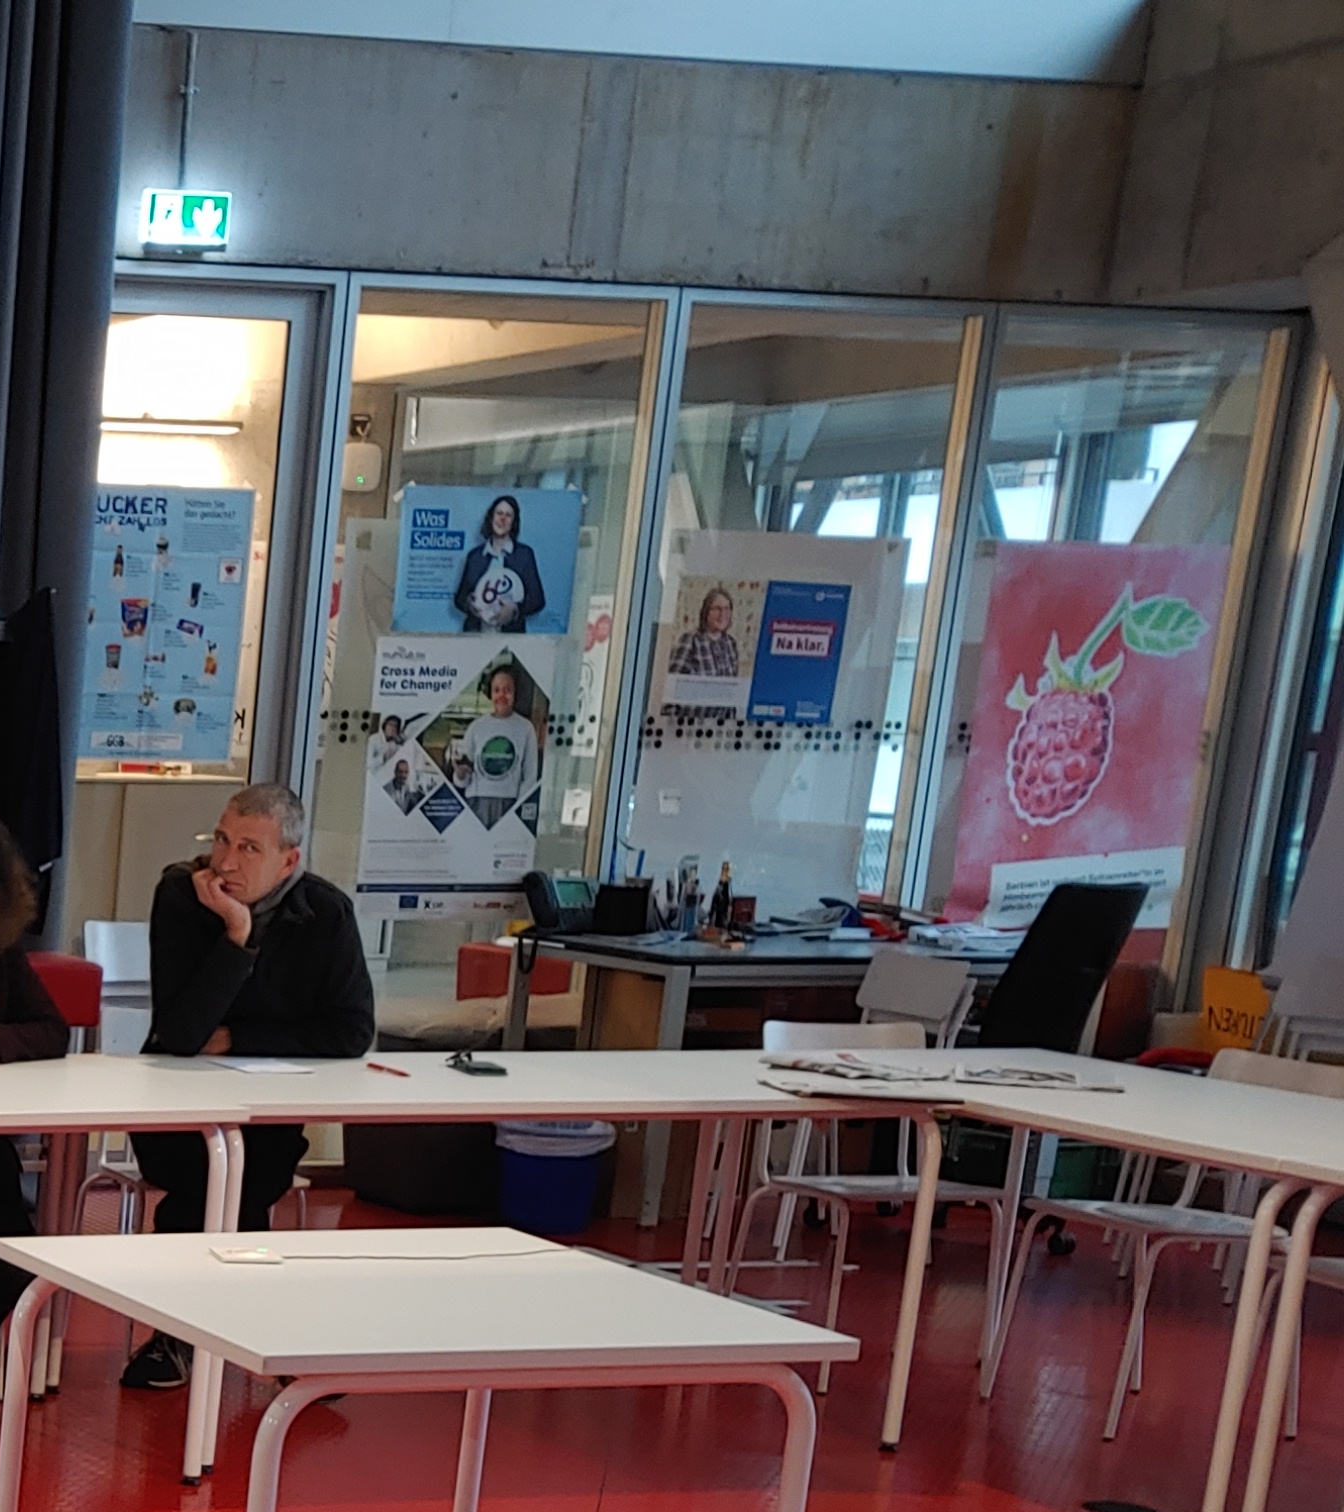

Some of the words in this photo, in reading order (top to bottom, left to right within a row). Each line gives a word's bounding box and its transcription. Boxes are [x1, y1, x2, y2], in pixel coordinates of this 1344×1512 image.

[96, 495, 168, 515] UCKER
[415, 510, 446, 526] Was
[413, 531, 462, 549] Solides
[775, 637, 794, 650] Na
[796, 638, 825, 652] klar.
[381, 666, 416, 677] Cross
[419, 665, 458, 677] Media
[380, 678, 398, 690] for
[400, 679, 452, 692] Change!
[1040, 877, 1051, 888] ist
